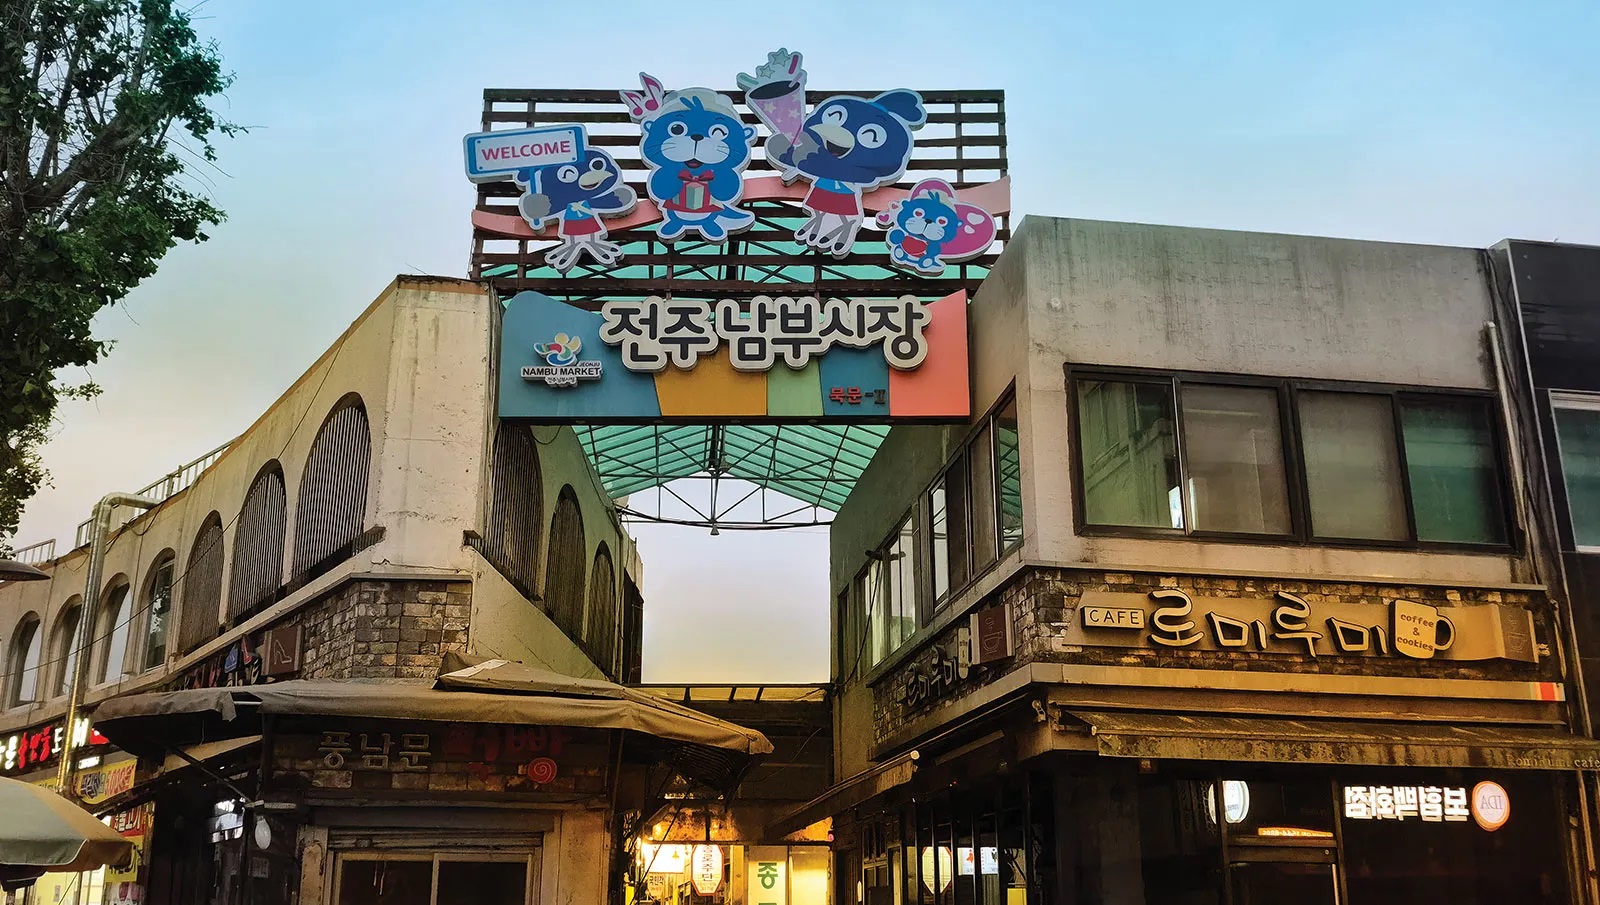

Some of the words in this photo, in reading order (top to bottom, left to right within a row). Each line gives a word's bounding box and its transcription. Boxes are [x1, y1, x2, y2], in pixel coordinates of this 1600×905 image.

[482, 140, 571, 160] WELCOME
[522, 367, 558, 376] NAMBU
[559, 367, 600, 376] MARKET
[1089, 609, 1140, 625] CAFE
[1150, 588, 1388, 658] 로미루미
[1401, 613, 1434, 628] coffee
[1412, 627, 1420, 636] &
[1397, 636, 1433, 651] cookies
[318, 731, 432, 770] 풍남문
